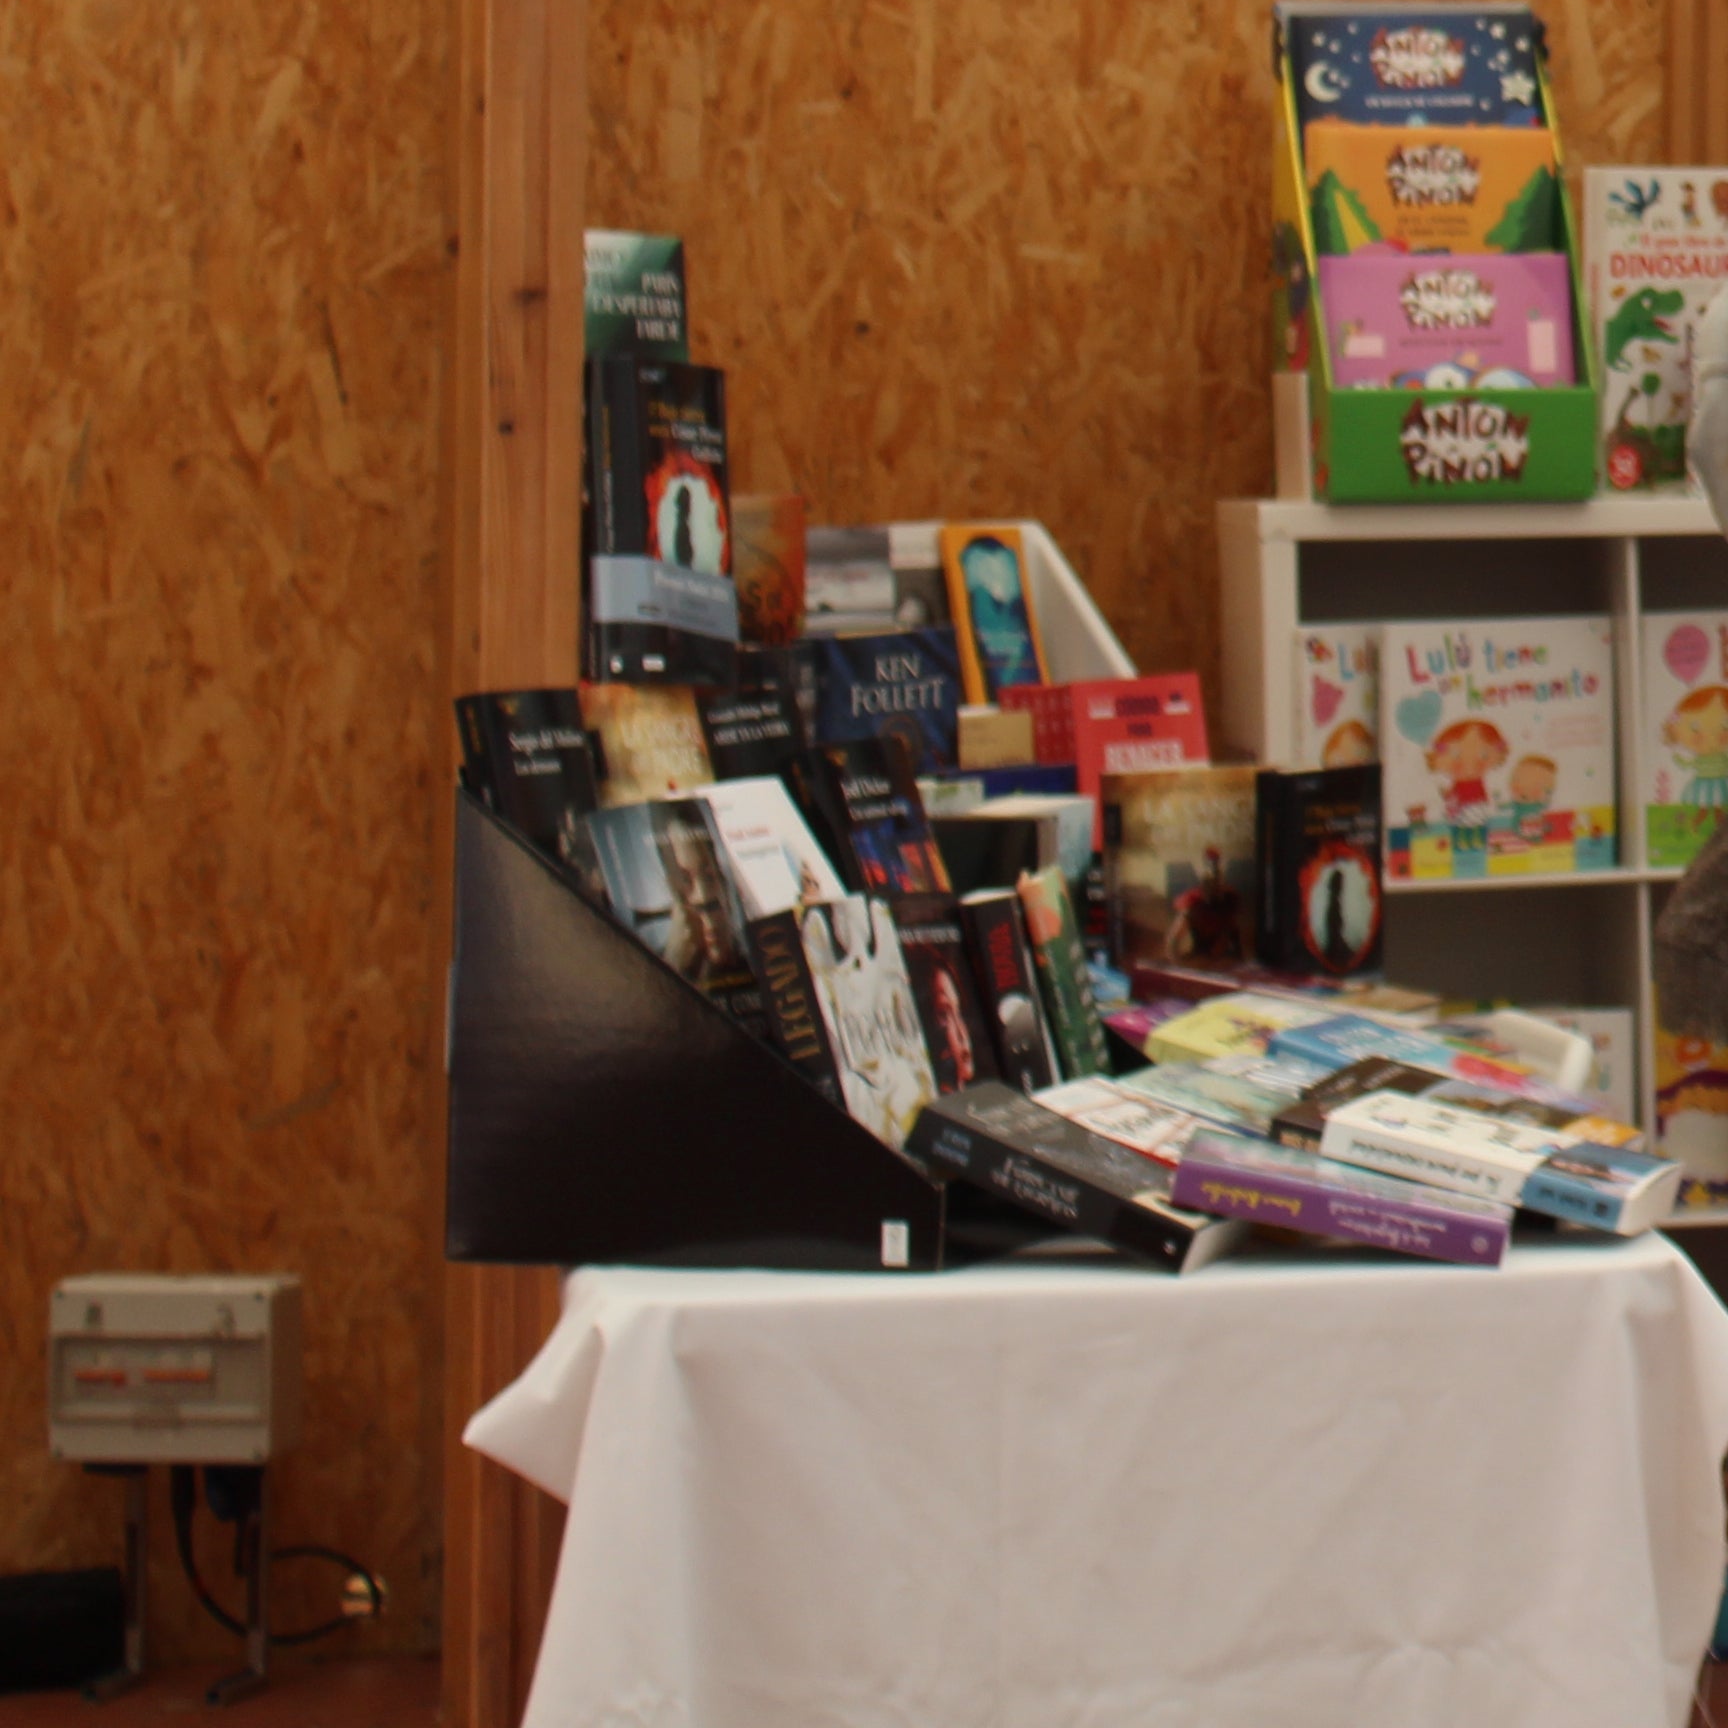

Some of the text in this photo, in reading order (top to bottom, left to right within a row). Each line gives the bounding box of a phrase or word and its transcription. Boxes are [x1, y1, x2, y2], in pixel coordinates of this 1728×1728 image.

[875, 652, 921, 684] KEN
[1467, 668, 1600, 710] hermanito
[851, 676, 944, 719] FOLLETT
